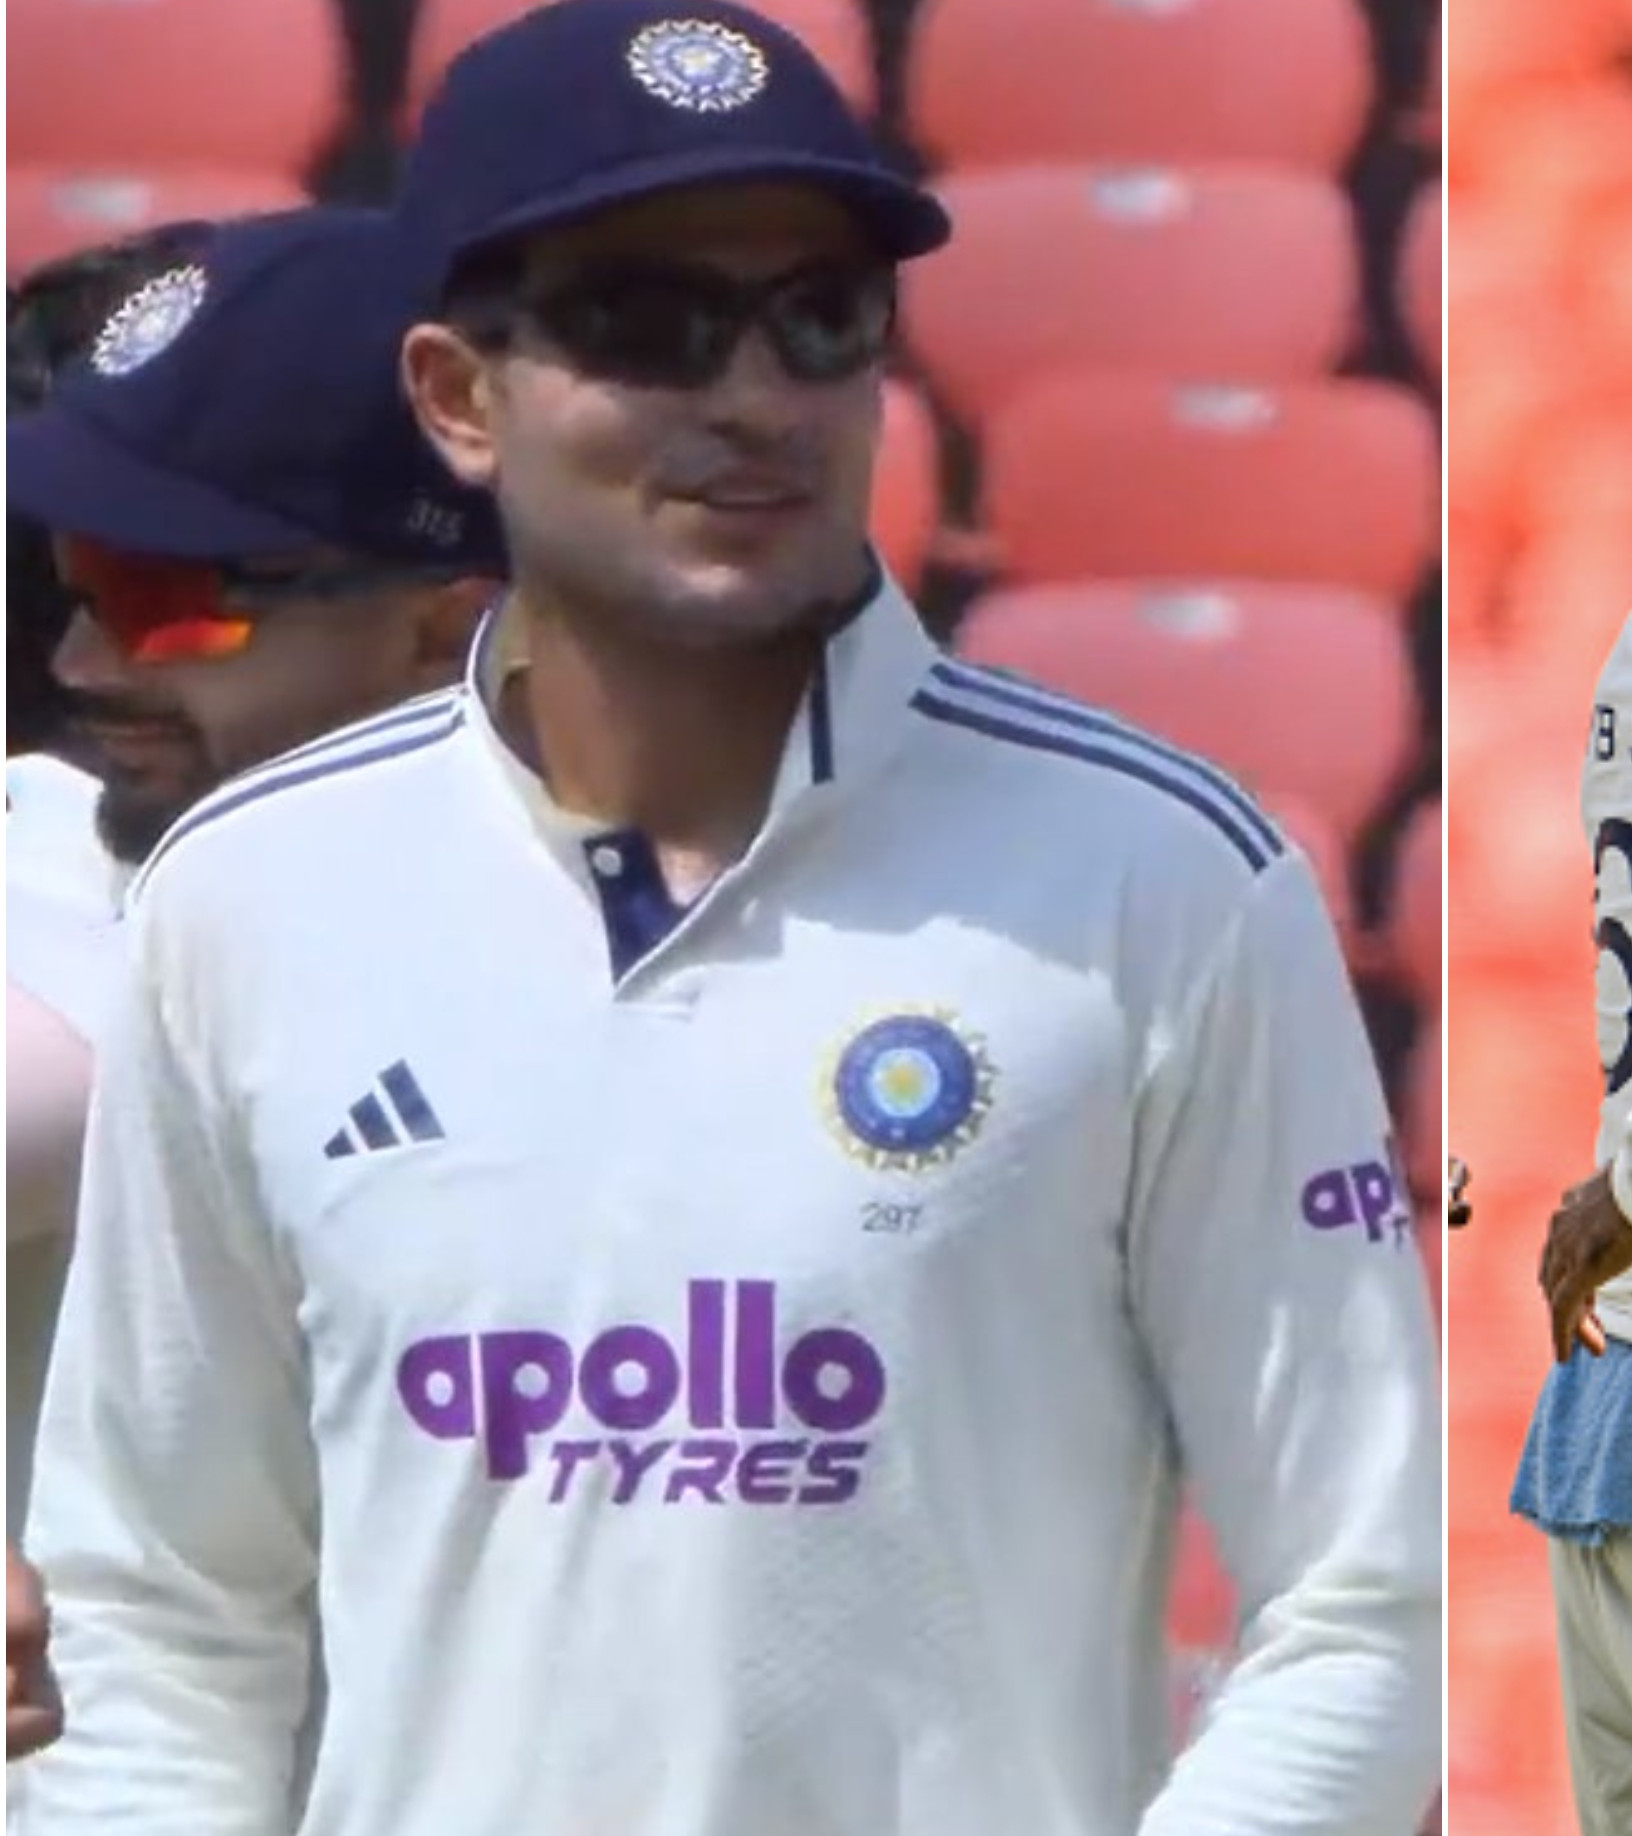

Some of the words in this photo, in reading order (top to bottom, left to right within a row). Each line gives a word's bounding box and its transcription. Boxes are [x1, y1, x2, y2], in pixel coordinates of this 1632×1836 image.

[859, 1202, 921, 1234] 297
[395, 1279, 886, 1480] apollo
[547, 1439, 868, 1504] TYRES
